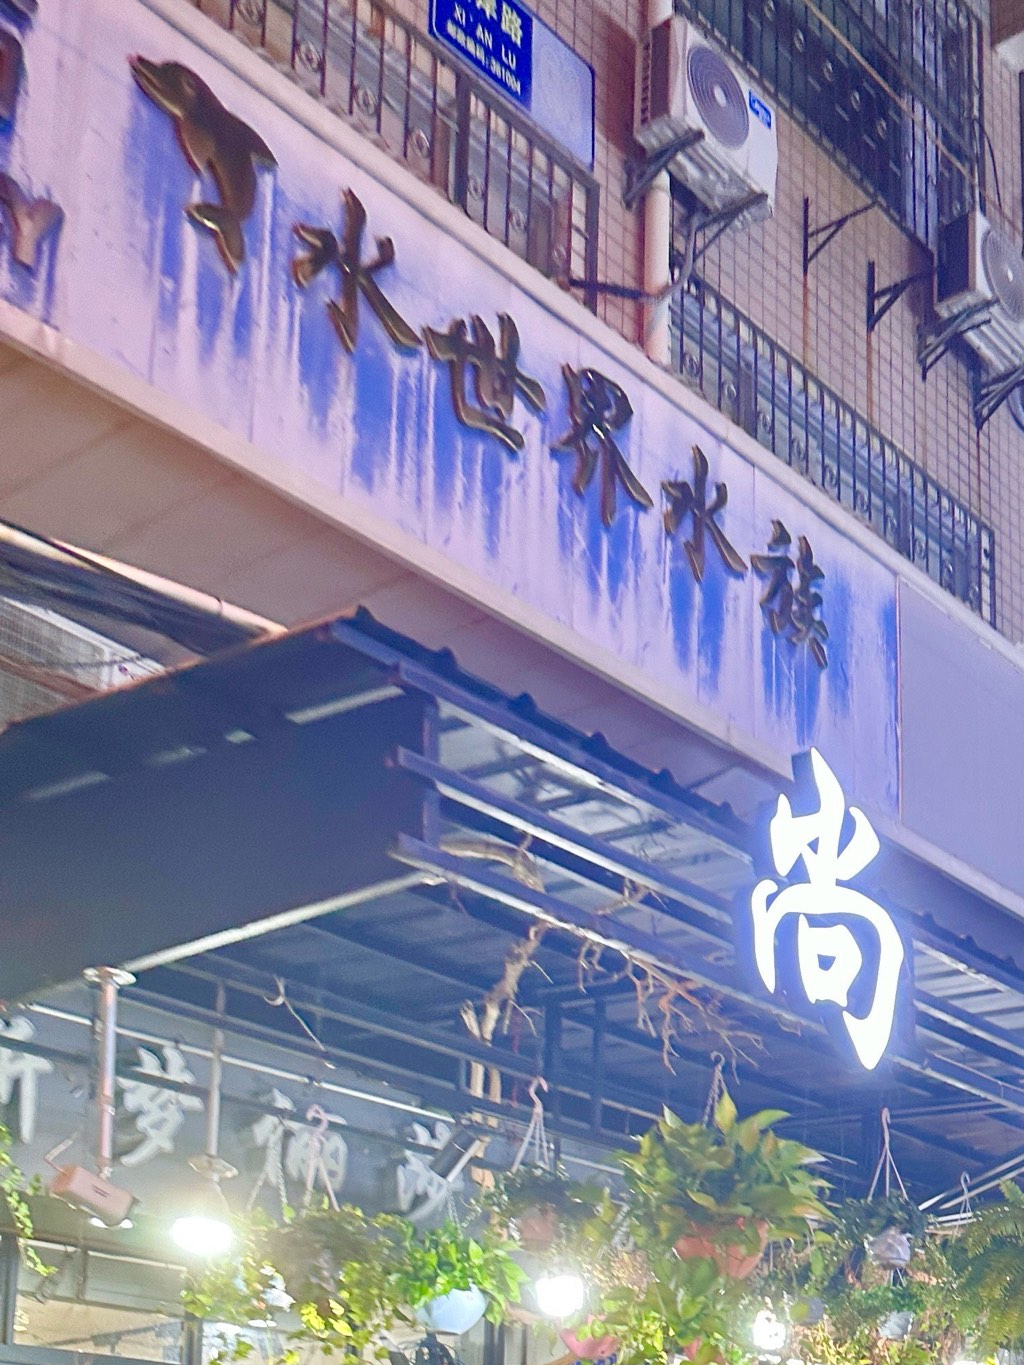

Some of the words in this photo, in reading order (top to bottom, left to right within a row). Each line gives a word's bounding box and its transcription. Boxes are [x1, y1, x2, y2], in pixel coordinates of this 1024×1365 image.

[501, 44, 517, 71] LU
[291, 187, 829, 668] 水世界水族
